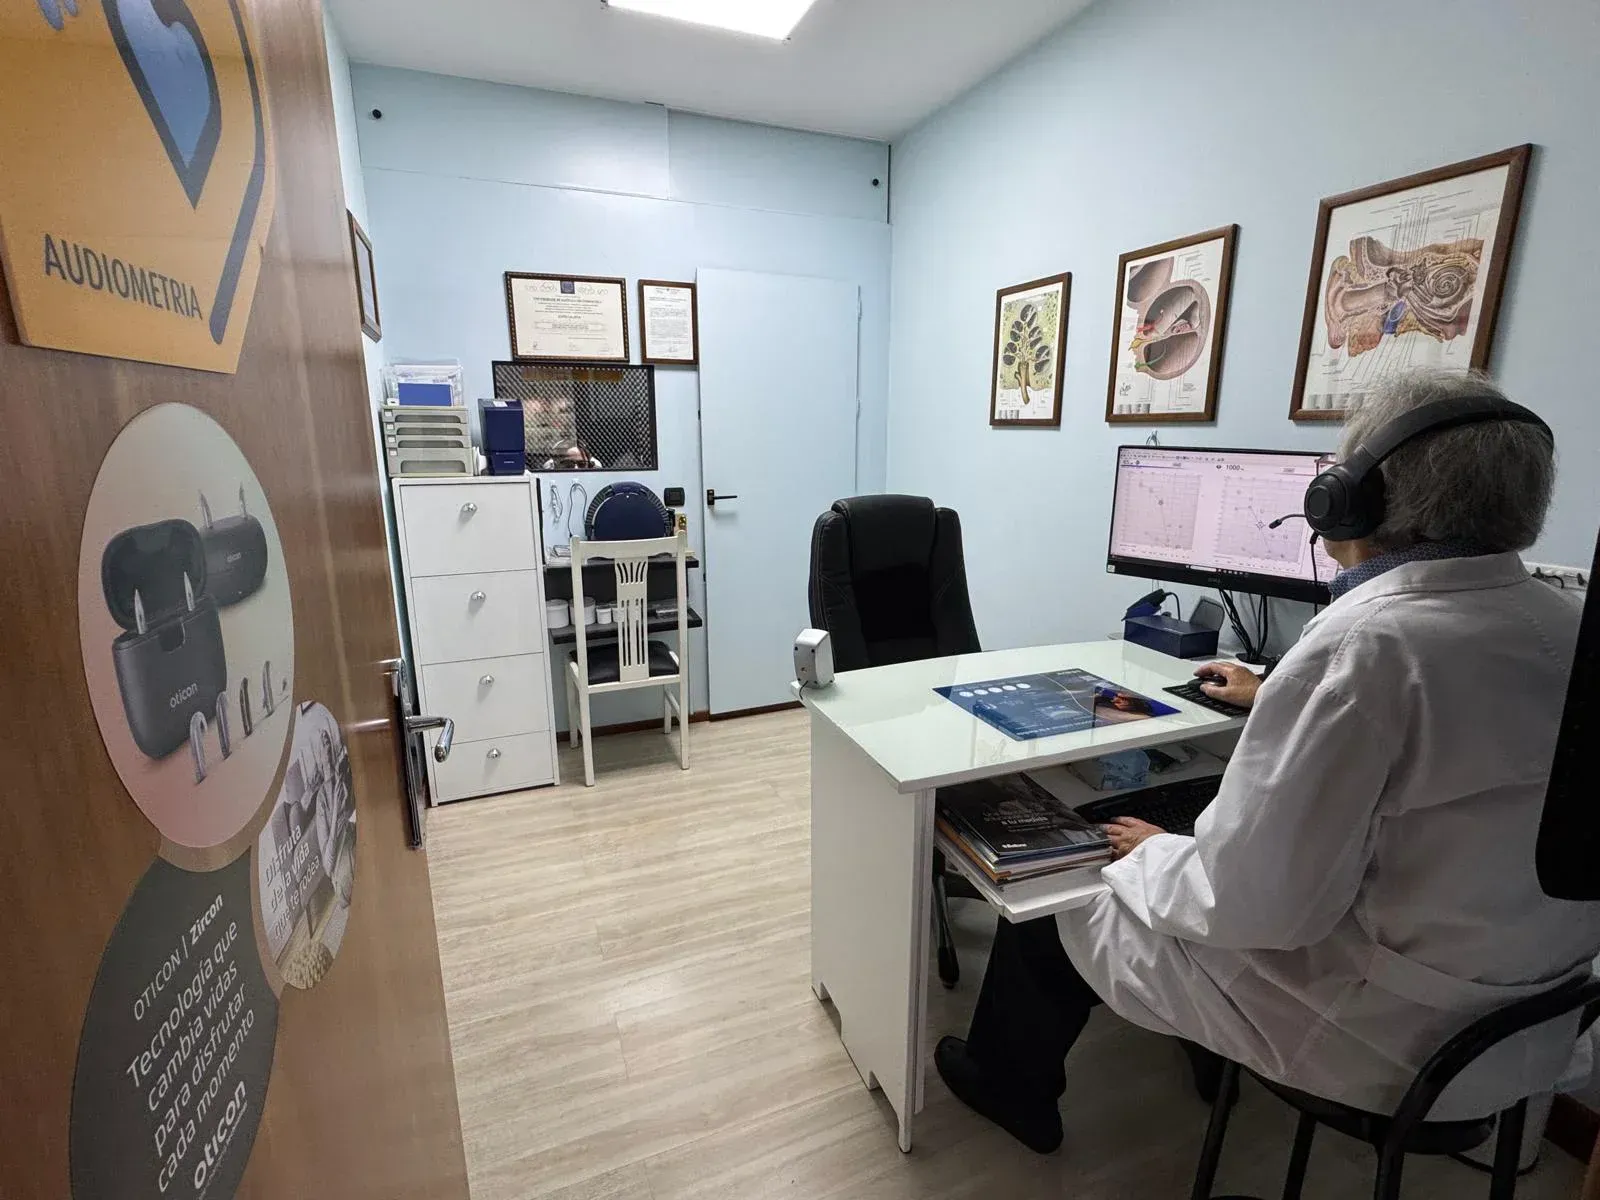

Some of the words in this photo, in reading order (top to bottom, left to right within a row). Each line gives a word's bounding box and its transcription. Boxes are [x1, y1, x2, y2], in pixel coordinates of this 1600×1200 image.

[44, 233, 203, 321] AUDIOMETRIA
[170, 683, 198, 708] oticon
[265, 824, 302, 888] Disfruta
[134, 948, 181, 1020] OTICON
[190, 894, 223, 945] Zircon
[213, 922, 237, 965] que
[149, 1017, 204, 1112] cambia
[203, 960, 238, 1019] vidas
[154, 1082, 192, 1158] para
[192, 983, 246, 1087] disfrutar
[158, 1118, 196, 1193] cada
[196, 1009, 255, 1123] momento
